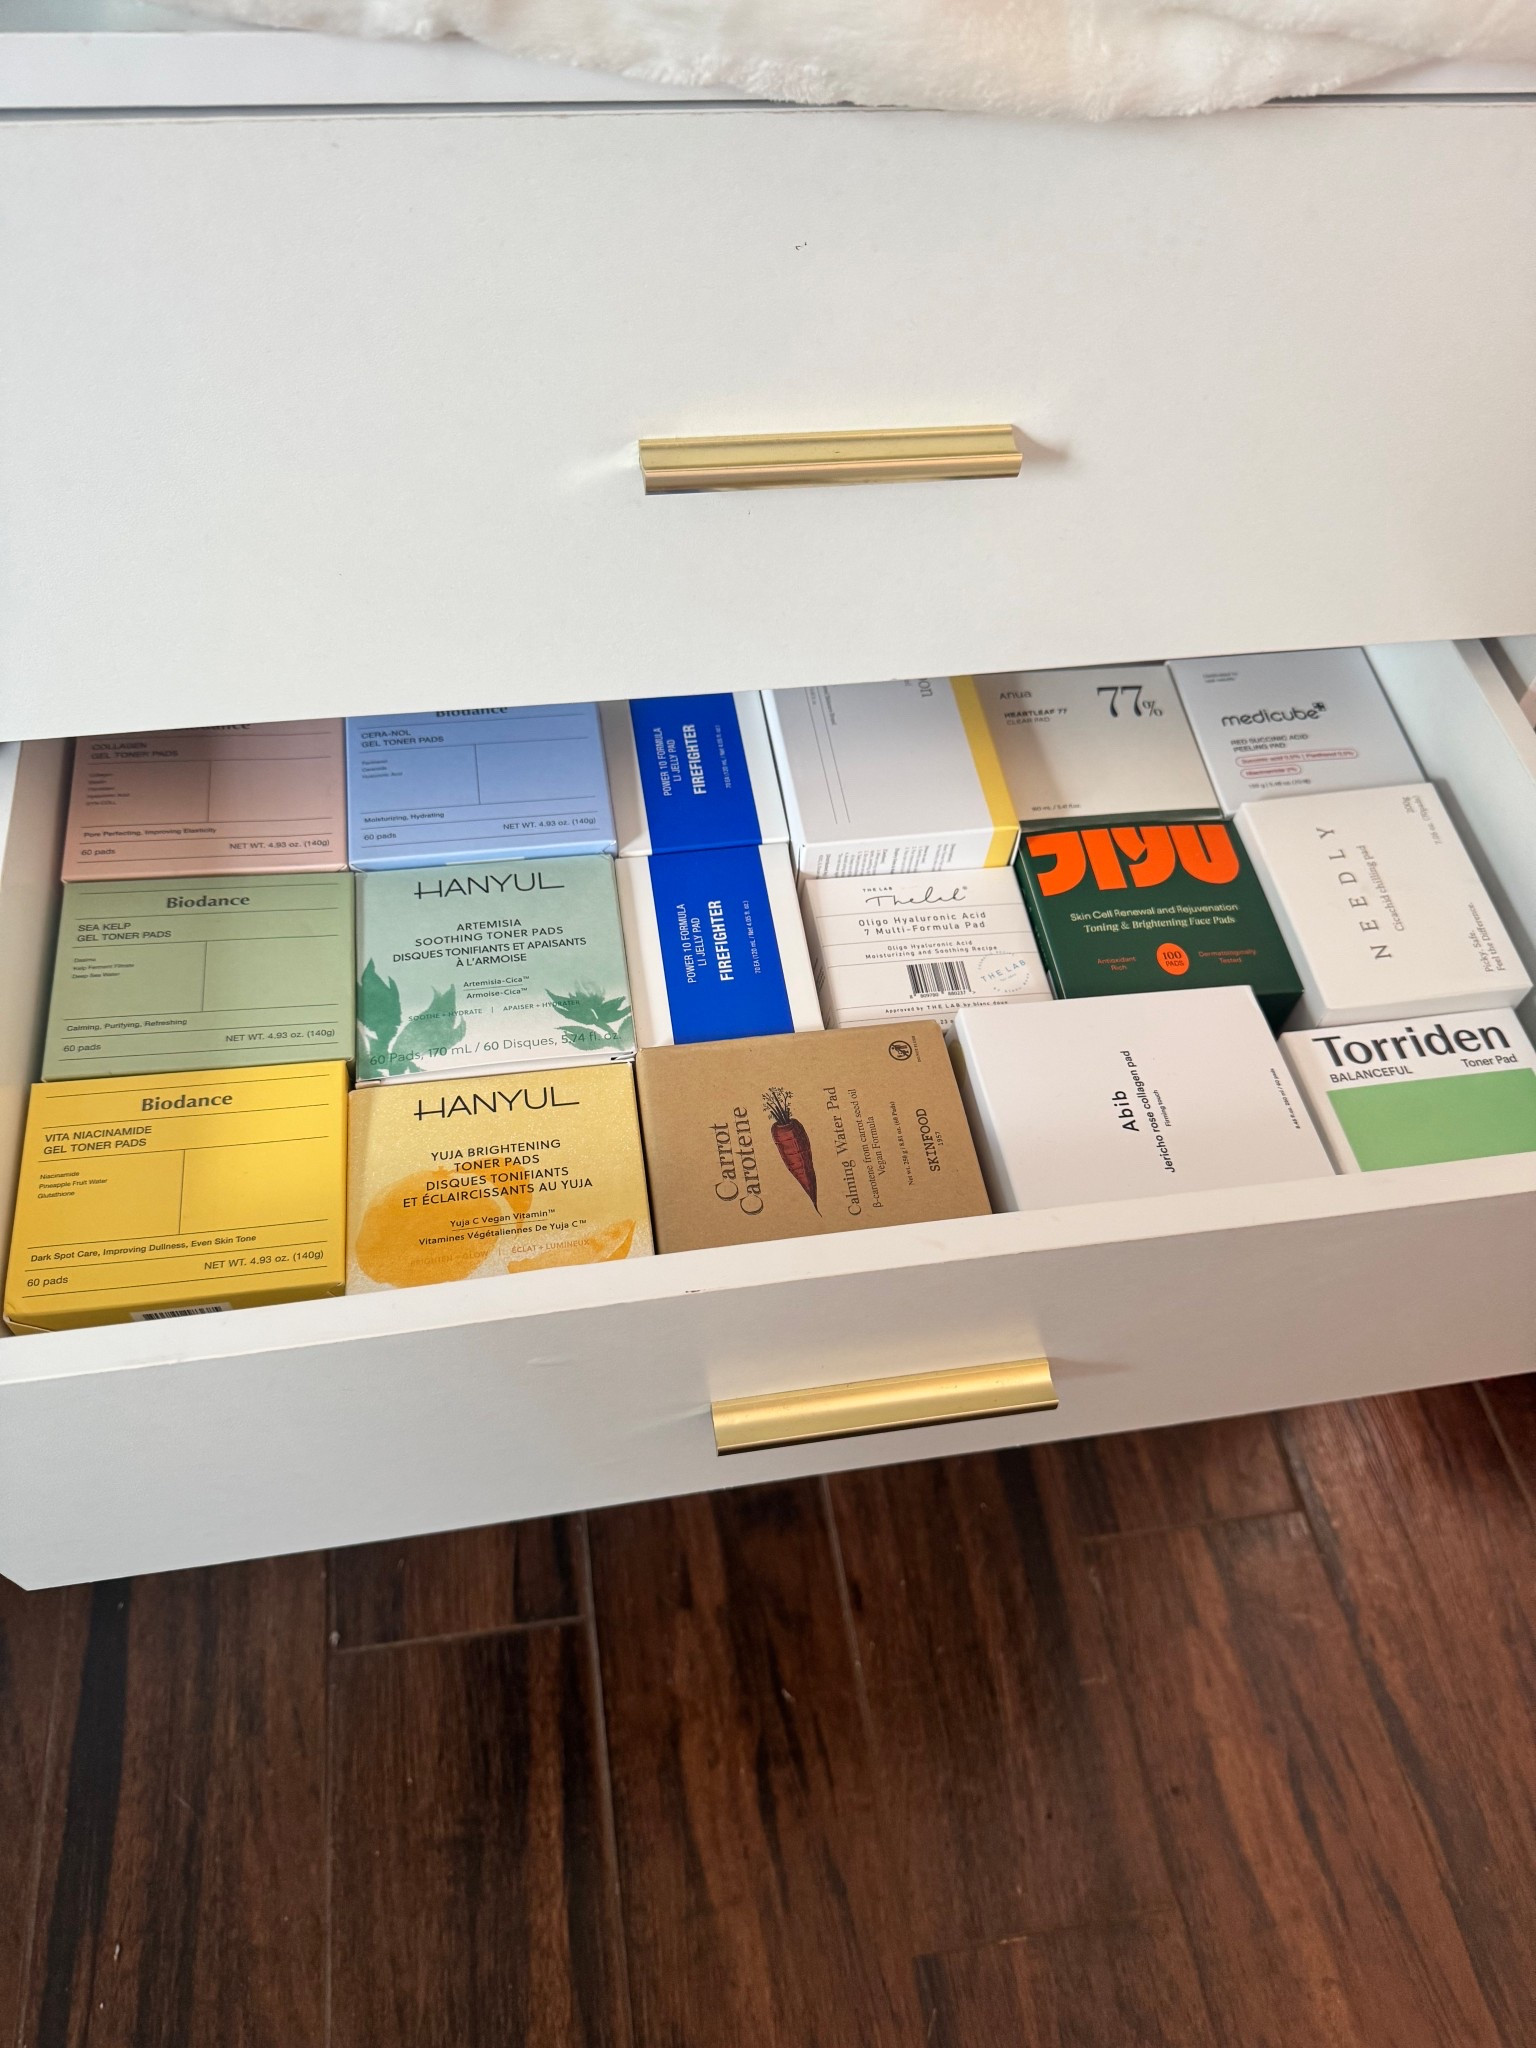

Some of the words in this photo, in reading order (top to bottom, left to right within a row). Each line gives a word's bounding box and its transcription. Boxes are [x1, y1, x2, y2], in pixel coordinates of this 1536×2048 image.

[1097, 686, 1162, 717] 77%
[1222, 707, 1320, 727] medicube
[361, 730, 411, 739] CERA-NOL
[361, 740, 381, 748] GEL
[383, 738, 416, 746] TONER
[418, 736, 444, 744] PADS
[654, 728, 665, 758] FORMULA
[668, 739, 676, 752] PAD
[660, 760, 668, 770] 10
[670, 753, 680, 773] JELLY
[682, 725, 707, 795] FIREFIGHTER
[663, 771, 673, 796] POWER
[410, 812, 444, 820] Hydrating
[1026, 825, 1240, 897] JIYU
[1356, 845, 1374, 860] pad
[414, 872, 564, 899] HANYUL
[1366, 860, 1388, 893] chilling
[167, 895, 249, 908] Biodance
[676, 904, 690, 941] FORMULA
[858, 918, 889, 928] Oligo
[893, 914, 956, 924] Hyaluronic
[962, 912, 986, 920] Acid
[1070, 912, 1091, 922] Skin
[1093, 910, 1112, 919] Cell
[1114, 907, 1155, 918] Renewal
[1157, 906, 1175, 914] and
[1177, 904, 1238, 914] Rejuvenation
[456, 919, 522, 931] ARTEMISIA
[691, 918, 701, 933] PAD
[876, 922, 960, 935] Multi-Formula
[1084, 923, 1119, 933] Toning
[1121, 921, 1129, 929] &
[1132, 917, 1188, 930] Brightening
[1190, 917, 1211, 925] Face
[1213, 915, 1235, 924] Pads
[77, 934, 98, 942] GEL
[102, 932, 140, 940] TONER
[143, 931, 171, 939] PADS
[415, 933, 483, 946] SOOTHING
[487, 929, 528, 939] TONER
[532, 926, 564, 936] PADS
[694, 935, 704, 956] JELLY
[708, 900, 735, 981] FIREFIGHTER
[393, 949, 443, 962] DISQUES
[445, 944, 510, 956] TONIFIANTS
[513, 942, 524, 950] ET
[527, 937, 587, 949] APAISANTS
[684, 942, 691, 953] 10
[1162, 951, 1182, 960] 100
[456, 956, 464, 967] À
[686, 955, 697, 983] POWER
[1166, 960, 1184, 968] PADS
[145, 1019, 187, 1027] Refreshing
[307, 1029, 335, 1038] (140g)
[78, 1043, 101, 1052] pads
[369, 1056, 386, 1066] 60
[389, 1050, 424, 1063] Pads,
[428, 1046, 447, 1058] 170
[451, 1044, 470, 1055] mL
[474, 1041, 480, 1054] /
[483, 1041, 500, 1051] 60
[503, 1036, 557, 1050] Disques,
[561, 1033, 586, 1044] 5.74
[589, 1030, 602, 1041] fl.
[604, 1030, 621, 1040] oz.
[1312, 1024, 1510, 1067] Torriden
[1120, 1050, 1137, 1069] pad
[1461, 1058, 1493, 1068] Toner
[1497, 1054, 1518, 1063] Pad
[1329, 1066, 1413, 1083] BALANCEFUL
[823, 1086, 840, 1111] Pad
[848, 1088, 857, 1099] oil
[1130, 1070, 1151, 1110] collagen
[141, 1094, 233, 1111] Biodance
[414, 1086, 579, 1120] HANYUL
[850, 1099, 862, 1119] seed
[1112, 1090, 1139, 1132] Abib
[856, 1119, 868, 1143] carrot
[1147, 1112, 1160, 1132] rose
[45, 1132, 70, 1142] VITA
[73, 1126, 152, 1140] NIACINAMIDE
[833, 1114, 849, 1157] Water
[867, 1116, 881, 1149] Formula
[916, 1108, 941, 1172] SKINFOOD
[934, 1132, 944, 1146] 1957
[43, 1146, 67, 1154] GEL
[70, 1141, 112, 1152] TONER
[115, 1139, 147, 1148] PADS
[431, 1150, 464, 1161] YUJA
[468, 1139, 561, 1157] BRIGHTENING
[862, 1143, 873, 1163] from
[1155, 1135, 1175, 1173] Jericho
[454, 1160, 500, 1172] TONER
[504, 1154, 540, 1166] PADS
[709, 1122, 739, 1202] Carrot
[732, 1106, 764, 1216] Carotene
[875, 1150, 887, 1176] Vegan
[426, 1176, 487, 1192] DISQUES
[490, 1167, 569, 1183] TONIFIANTS
[842, 1159, 862, 1217] Calming
[404, 1198, 417, 1208] ET
[422, 1184, 535, 1205] ÉCLAIRCISSANTS
[539, 1181, 557, 1192] AU
[561, 1178, 592, 1189] YUJA
[450, 1218, 470, 1227] Yuja
[472, 1216, 479, 1224] C
[482, 1214, 511, 1224] Vegan
[31, 1253, 51, 1262] Dark
[54, 1251, 75, 1260] Spot
[77, 1250, 101, 1258] Care,
[103, 1245, 147, 1256] Improving
[149, 1242, 188, 1251] Dullness,
[191, 1239, 212, 1247] Even
[214, 1236, 233, 1245] Skin
[236, 1234, 256, 1242] Tone
[204, 1260, 224, 1270] NET
[228, 1258, 247, 1267] WT.
[250, 1256, 272, 1265] 4.93
[275, 1255, 289, 1263] oz.
[293, 1250, 324, 1262] (140g)
[43, 1276, 68, 1286] pads
